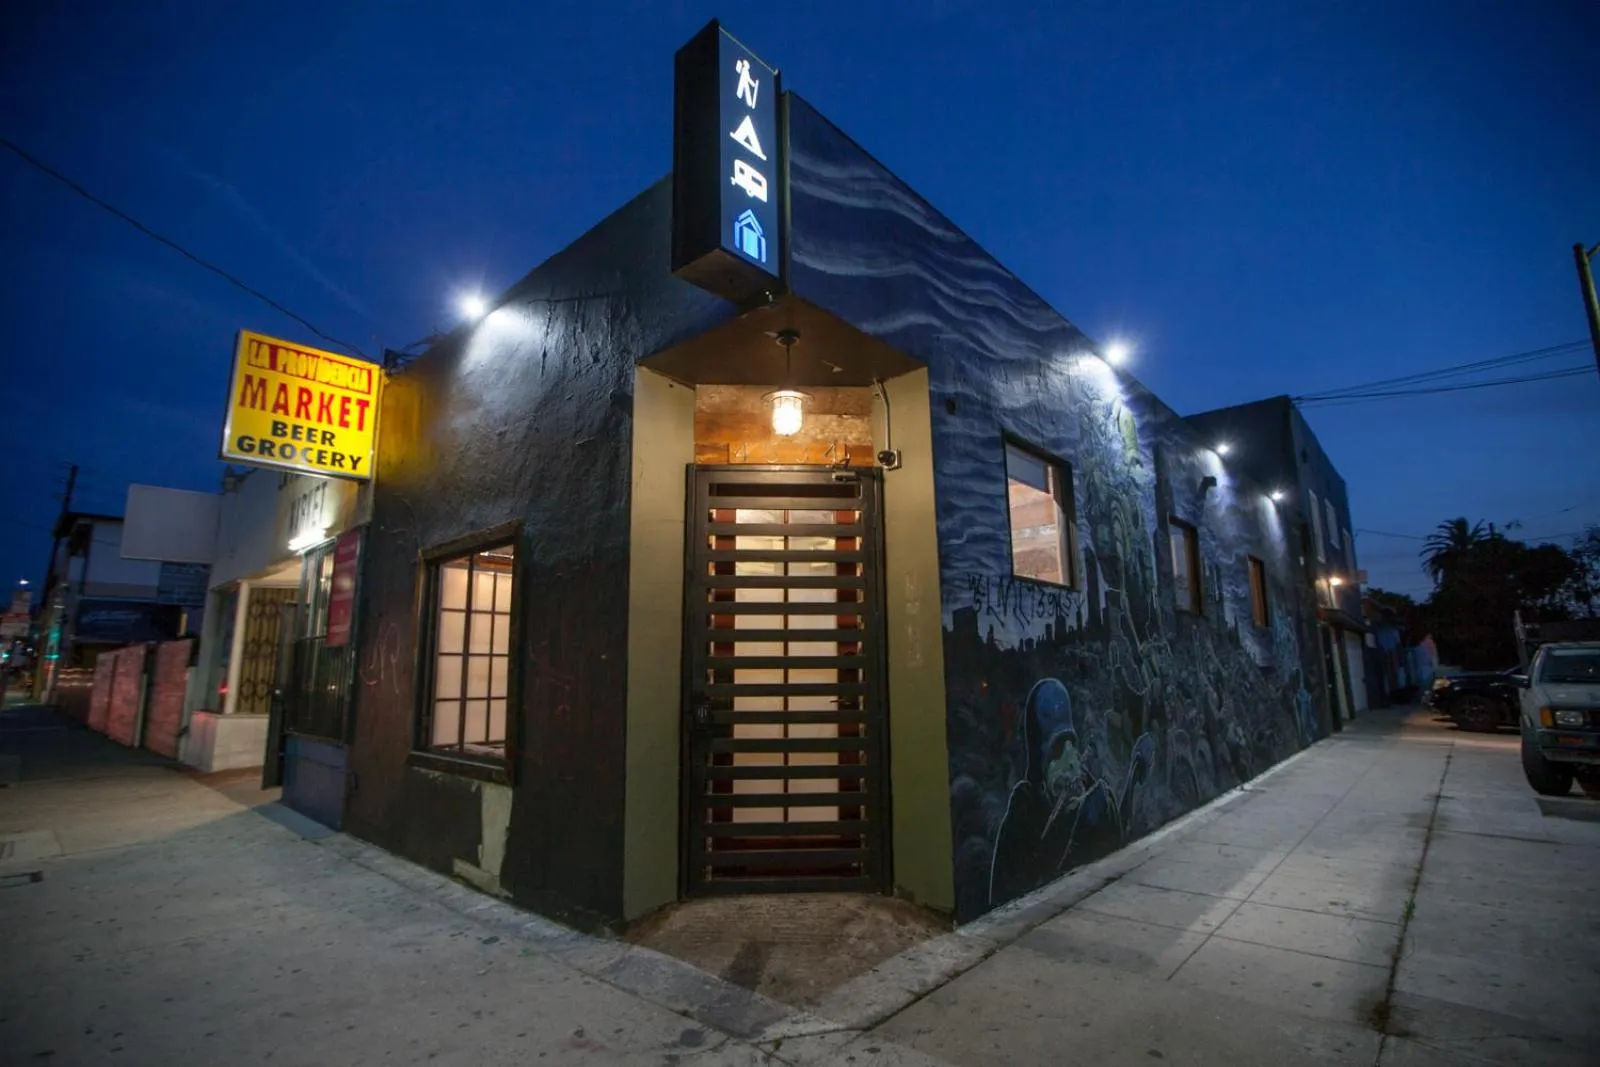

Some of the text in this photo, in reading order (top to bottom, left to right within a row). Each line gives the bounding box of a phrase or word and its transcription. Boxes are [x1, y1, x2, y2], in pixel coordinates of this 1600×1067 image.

[239, 374, 370, 431] MARKET
[271, 420, 336, 447] BEER
[236, 435, 362, 471] GROCERY
